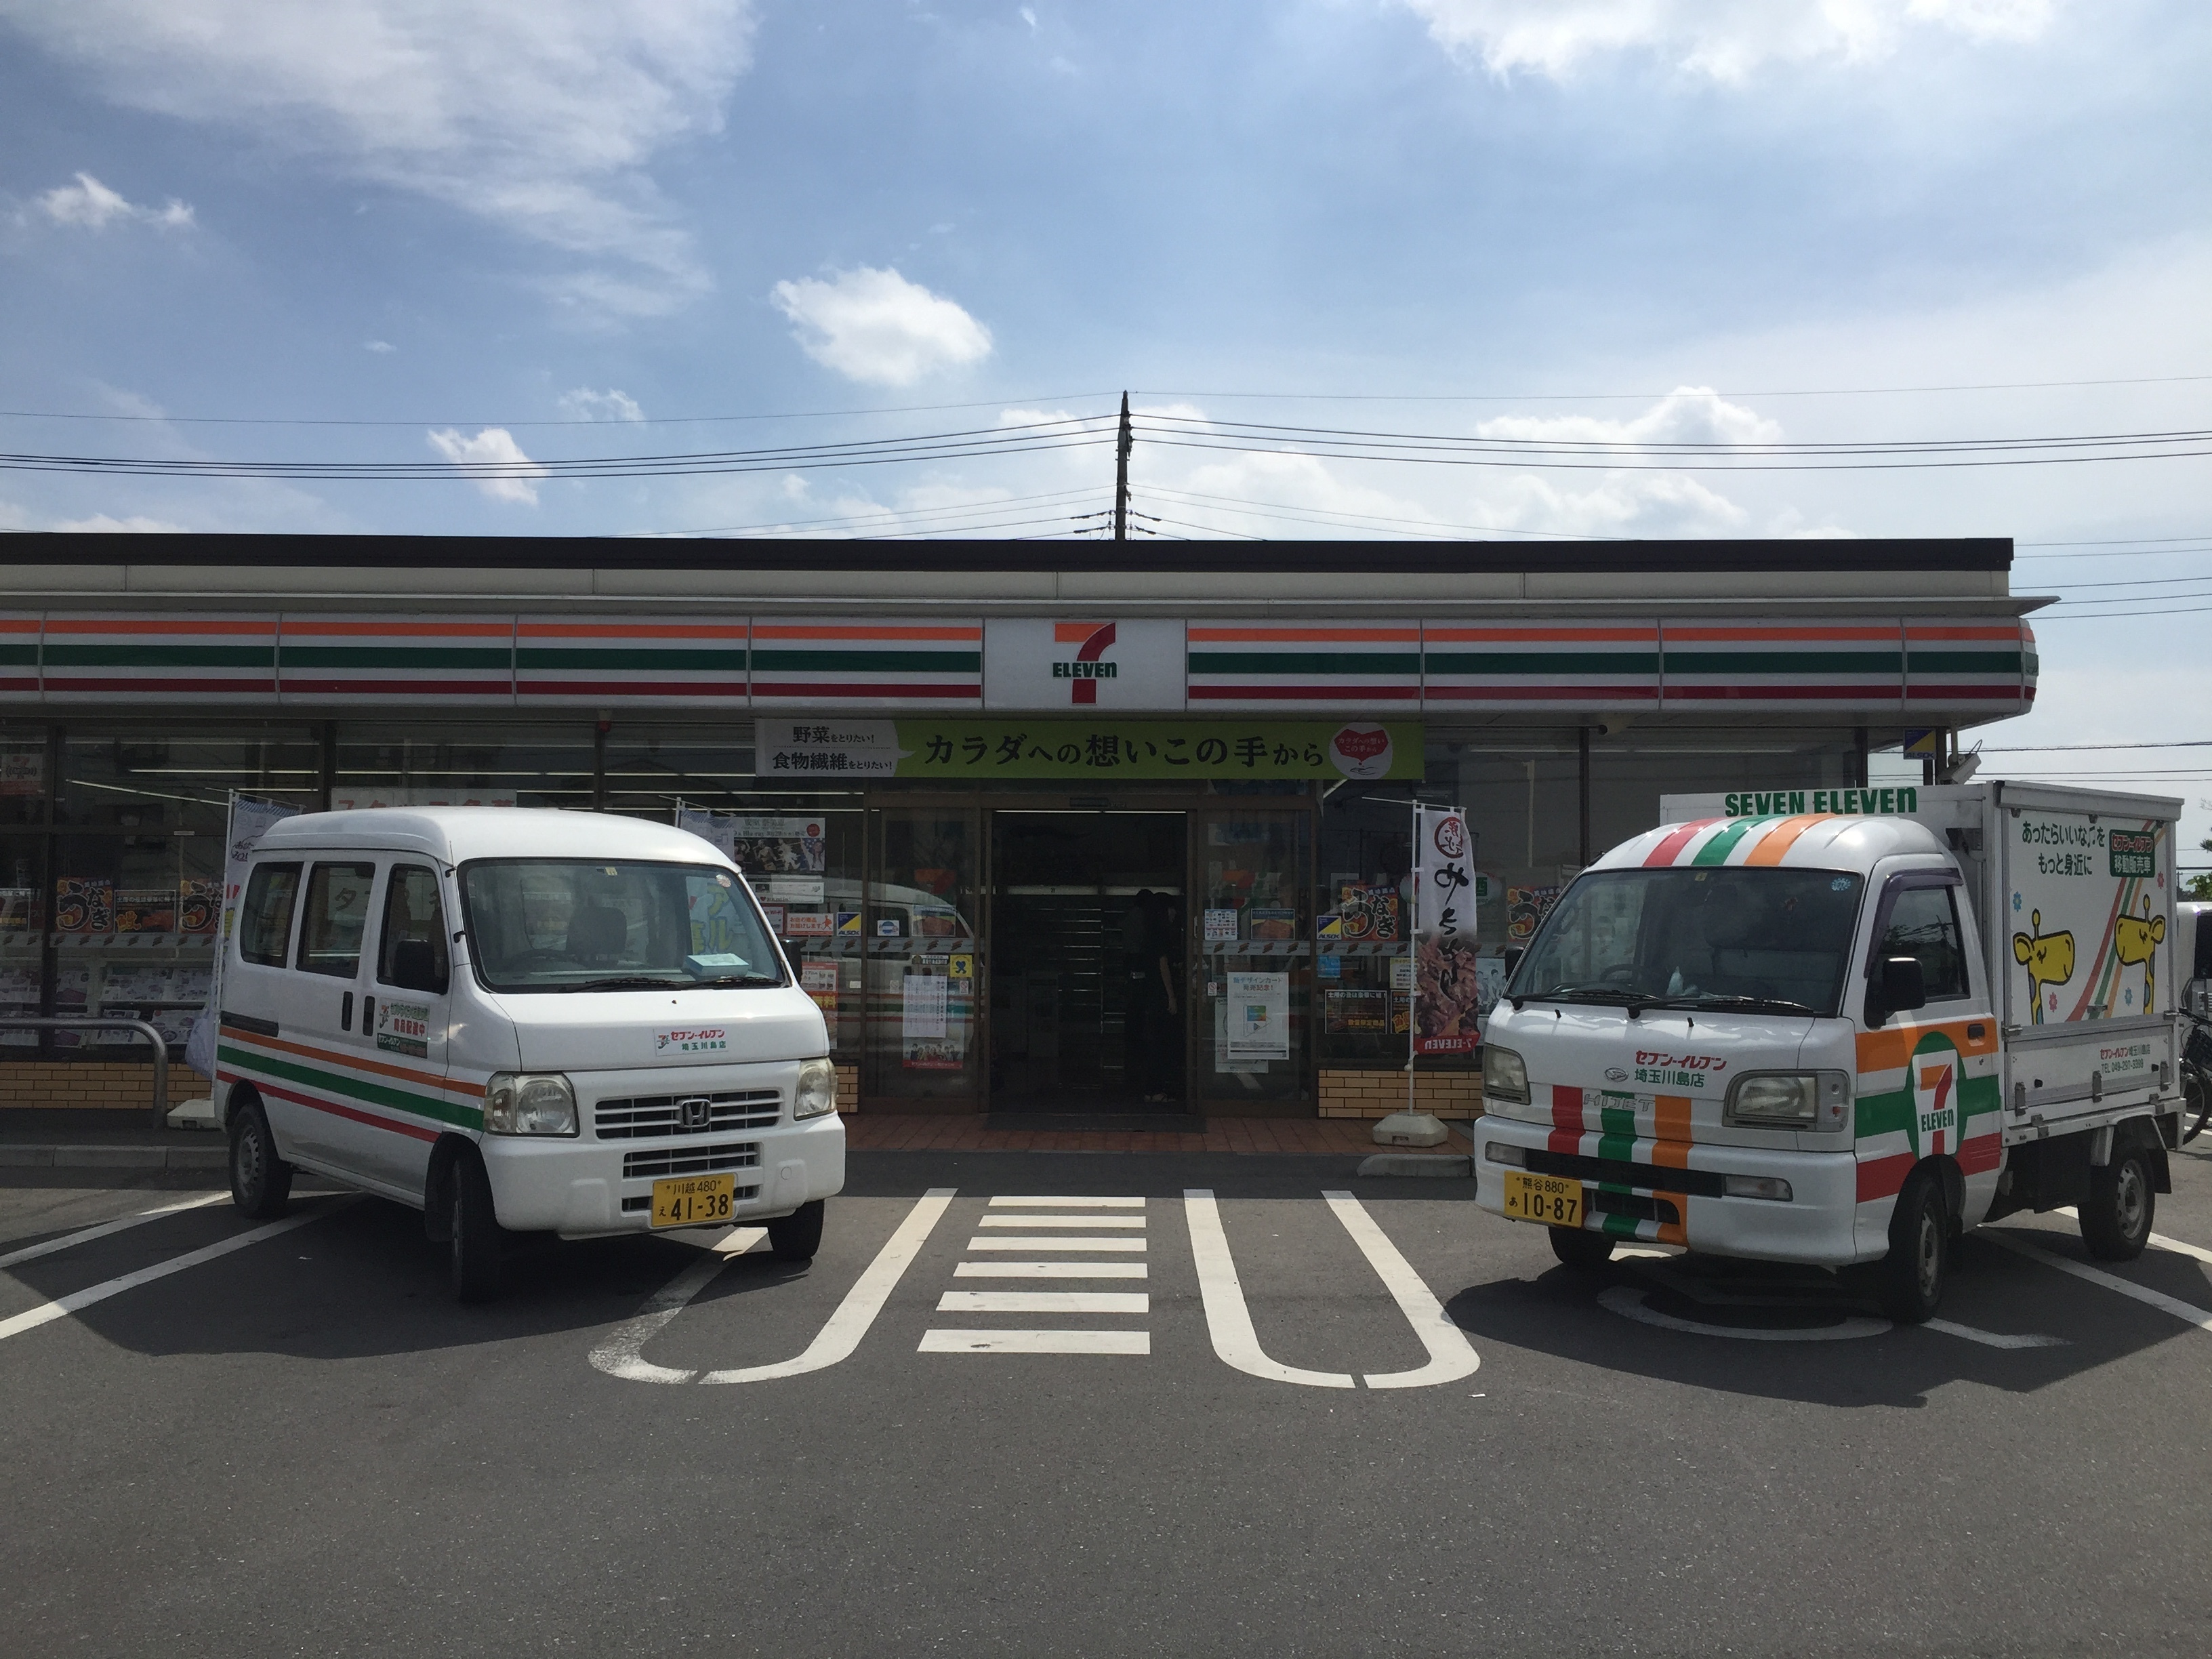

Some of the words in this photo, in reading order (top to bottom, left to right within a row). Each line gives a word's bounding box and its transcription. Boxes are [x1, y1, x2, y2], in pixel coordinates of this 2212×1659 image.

[924, 733, 1325, 768] カラダへの想いこの手から
[1725, 792, 1805, 817] SEVEN
[2038, 853, 2093, 876] もっと身近に
[2114, 854, 2151, 874] 移動販売車
[1634, 1069, 1705, 1088] 埼玉川島店
[1584, 1093, 1656, 1112] HIJET
[670, 1193, 729, 1221] 41-38
[1523, 1192, 1577, 1223] 10-87
